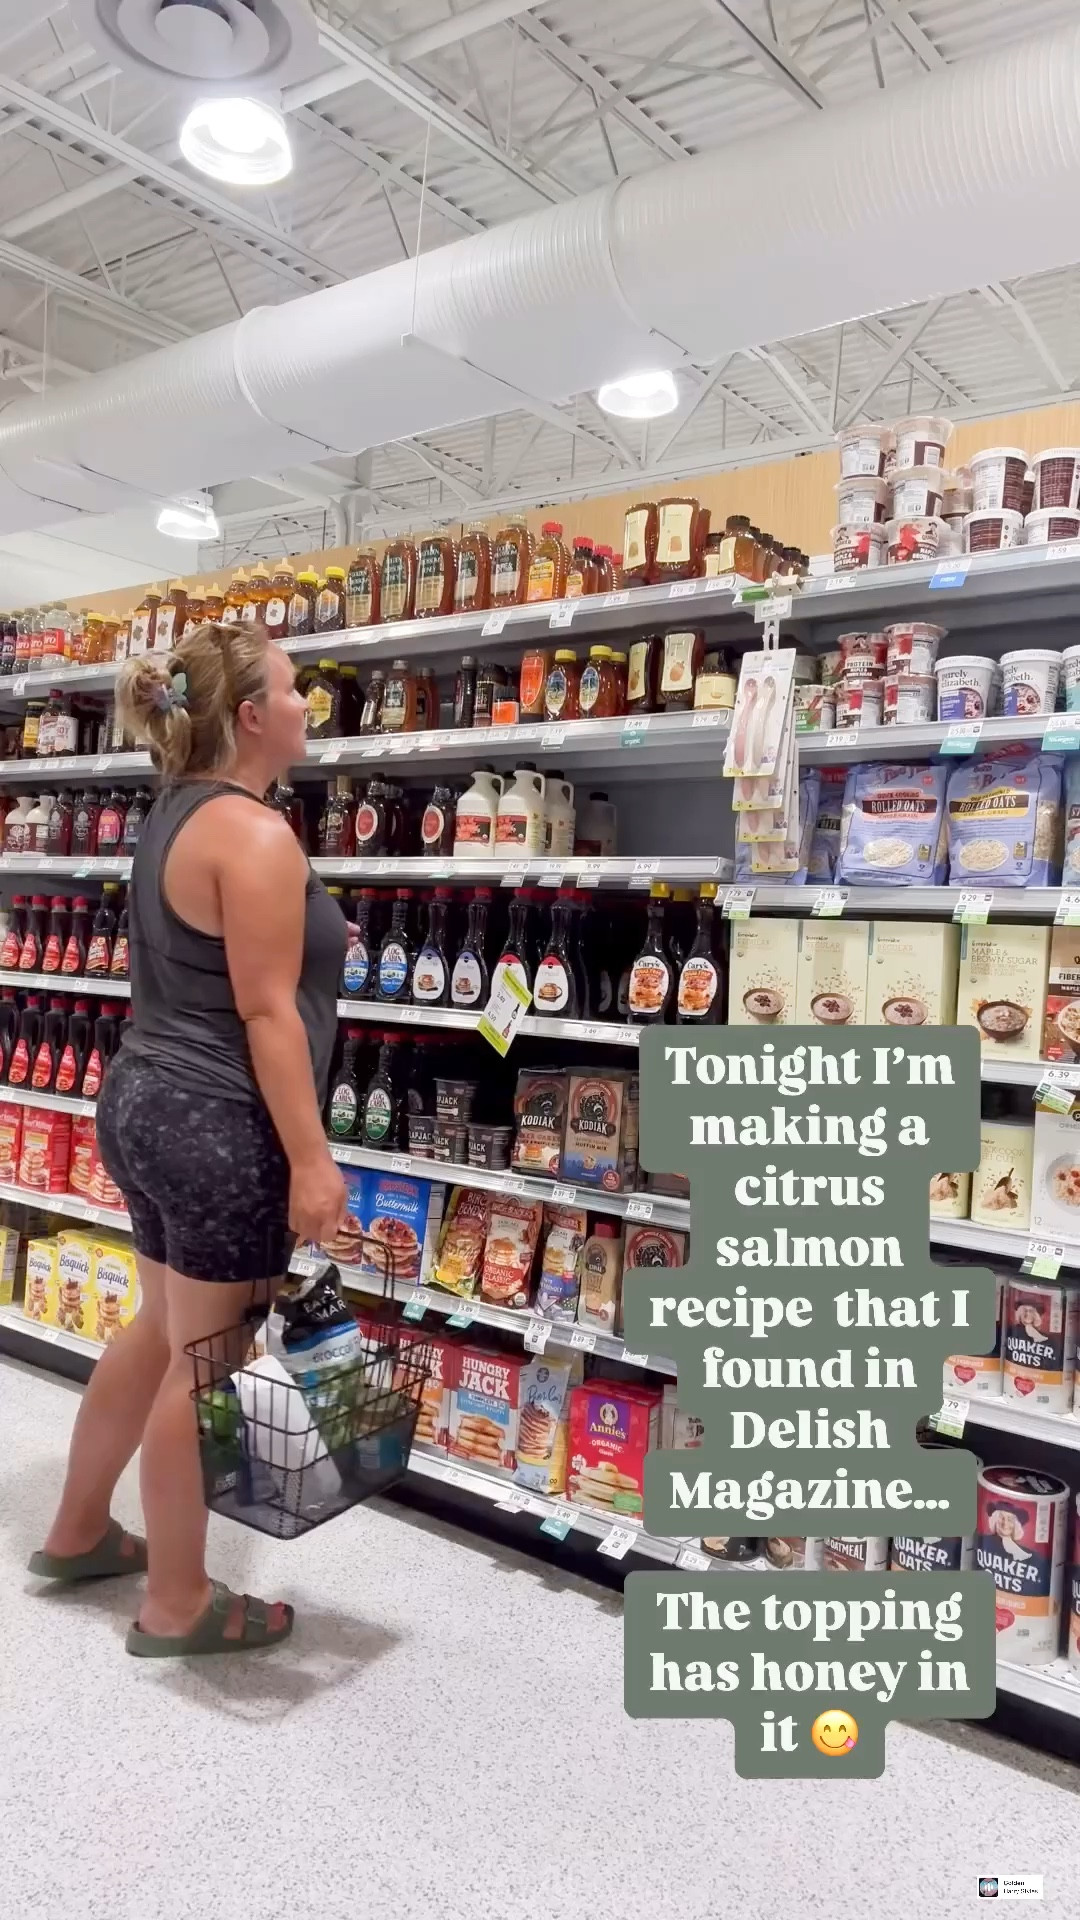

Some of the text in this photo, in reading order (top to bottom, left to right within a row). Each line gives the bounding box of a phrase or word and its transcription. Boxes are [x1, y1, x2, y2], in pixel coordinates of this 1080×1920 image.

[871, 799, 926, 812] ROLLED OATS
[959, 795, 1016, 812] ROLLED OATS
[971, 947, 1000, 956] MAPLE
[971, 955, 1038, 966] BROWN SUGAR
[1048, 1070, 1070, 1079] 6.39
[521, 1114, 555, 1130] KODIAK
[578, 1119, 608, 1135] KODIAK
[375, 1192, 419, 1214] Buttermilk
[1034, 1216, 1042, 1226] 12
[29, 1258, 52, 1273] Bisquick
[60, 1254, 90, 1275] Bisquick
[484, 1265, 514, 1279] ORGANIC
[97, 1266, 129, 1288] Bisquick
[1007, 1336, 1054, 1360] QUAKER
[1012, 1349, 1041, 1367] OATS
[462, 1355, 510, 1380] HUNGRY
[458, 1368, 511, 1401] JACK
[589, 1421, 627, 1440] Annie's
[591, 1439, 622, 1453] ORGANIC
[830, 1541, 865, 1561] OATMEAL
[899, 1551, 933, 1571] OATS
[976, 1548, 1039, 1583] QUAKER
[985, 1569, 1022, 1593] ATS
